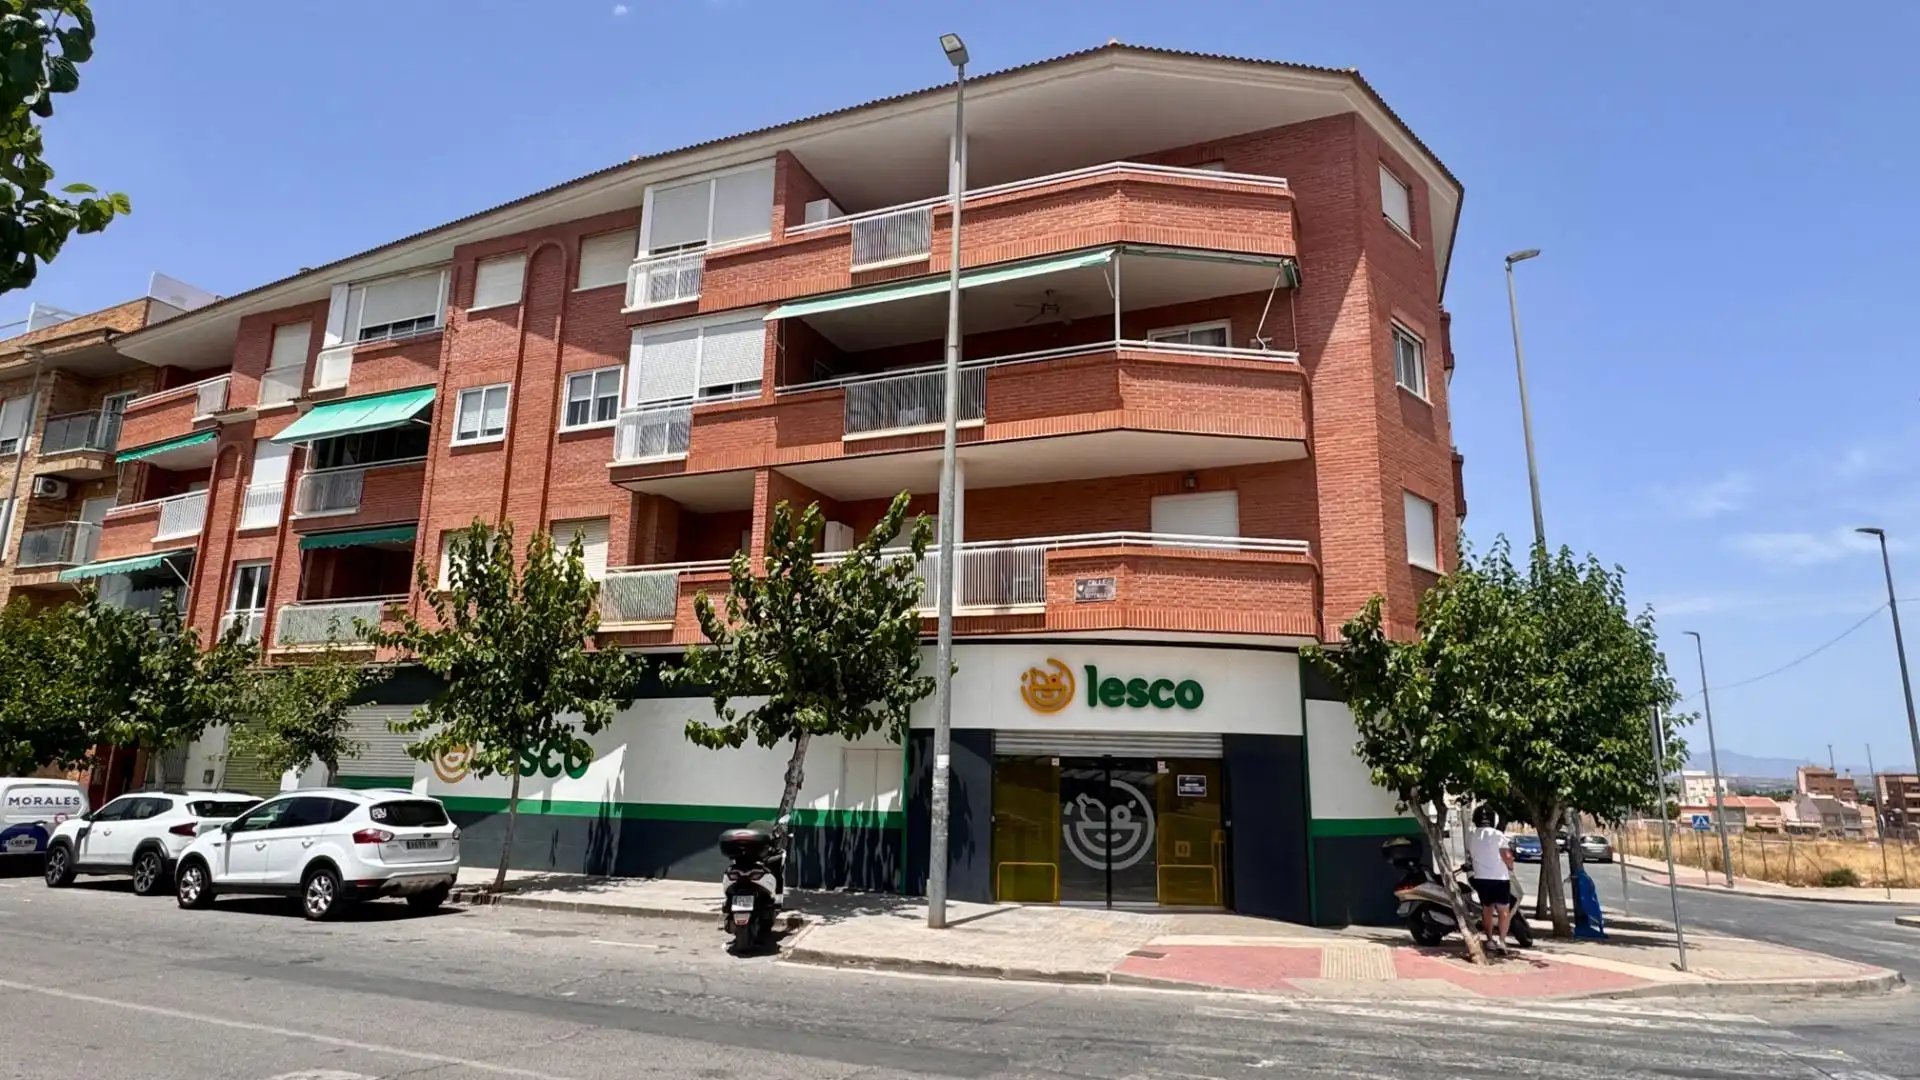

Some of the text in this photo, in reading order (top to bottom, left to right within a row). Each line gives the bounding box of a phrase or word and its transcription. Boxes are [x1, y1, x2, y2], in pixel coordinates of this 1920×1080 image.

[1084, 665, 1204, 709] lesco
[491, 738, 594, 779] sco
[8, 796, 80, 806] MORALES
